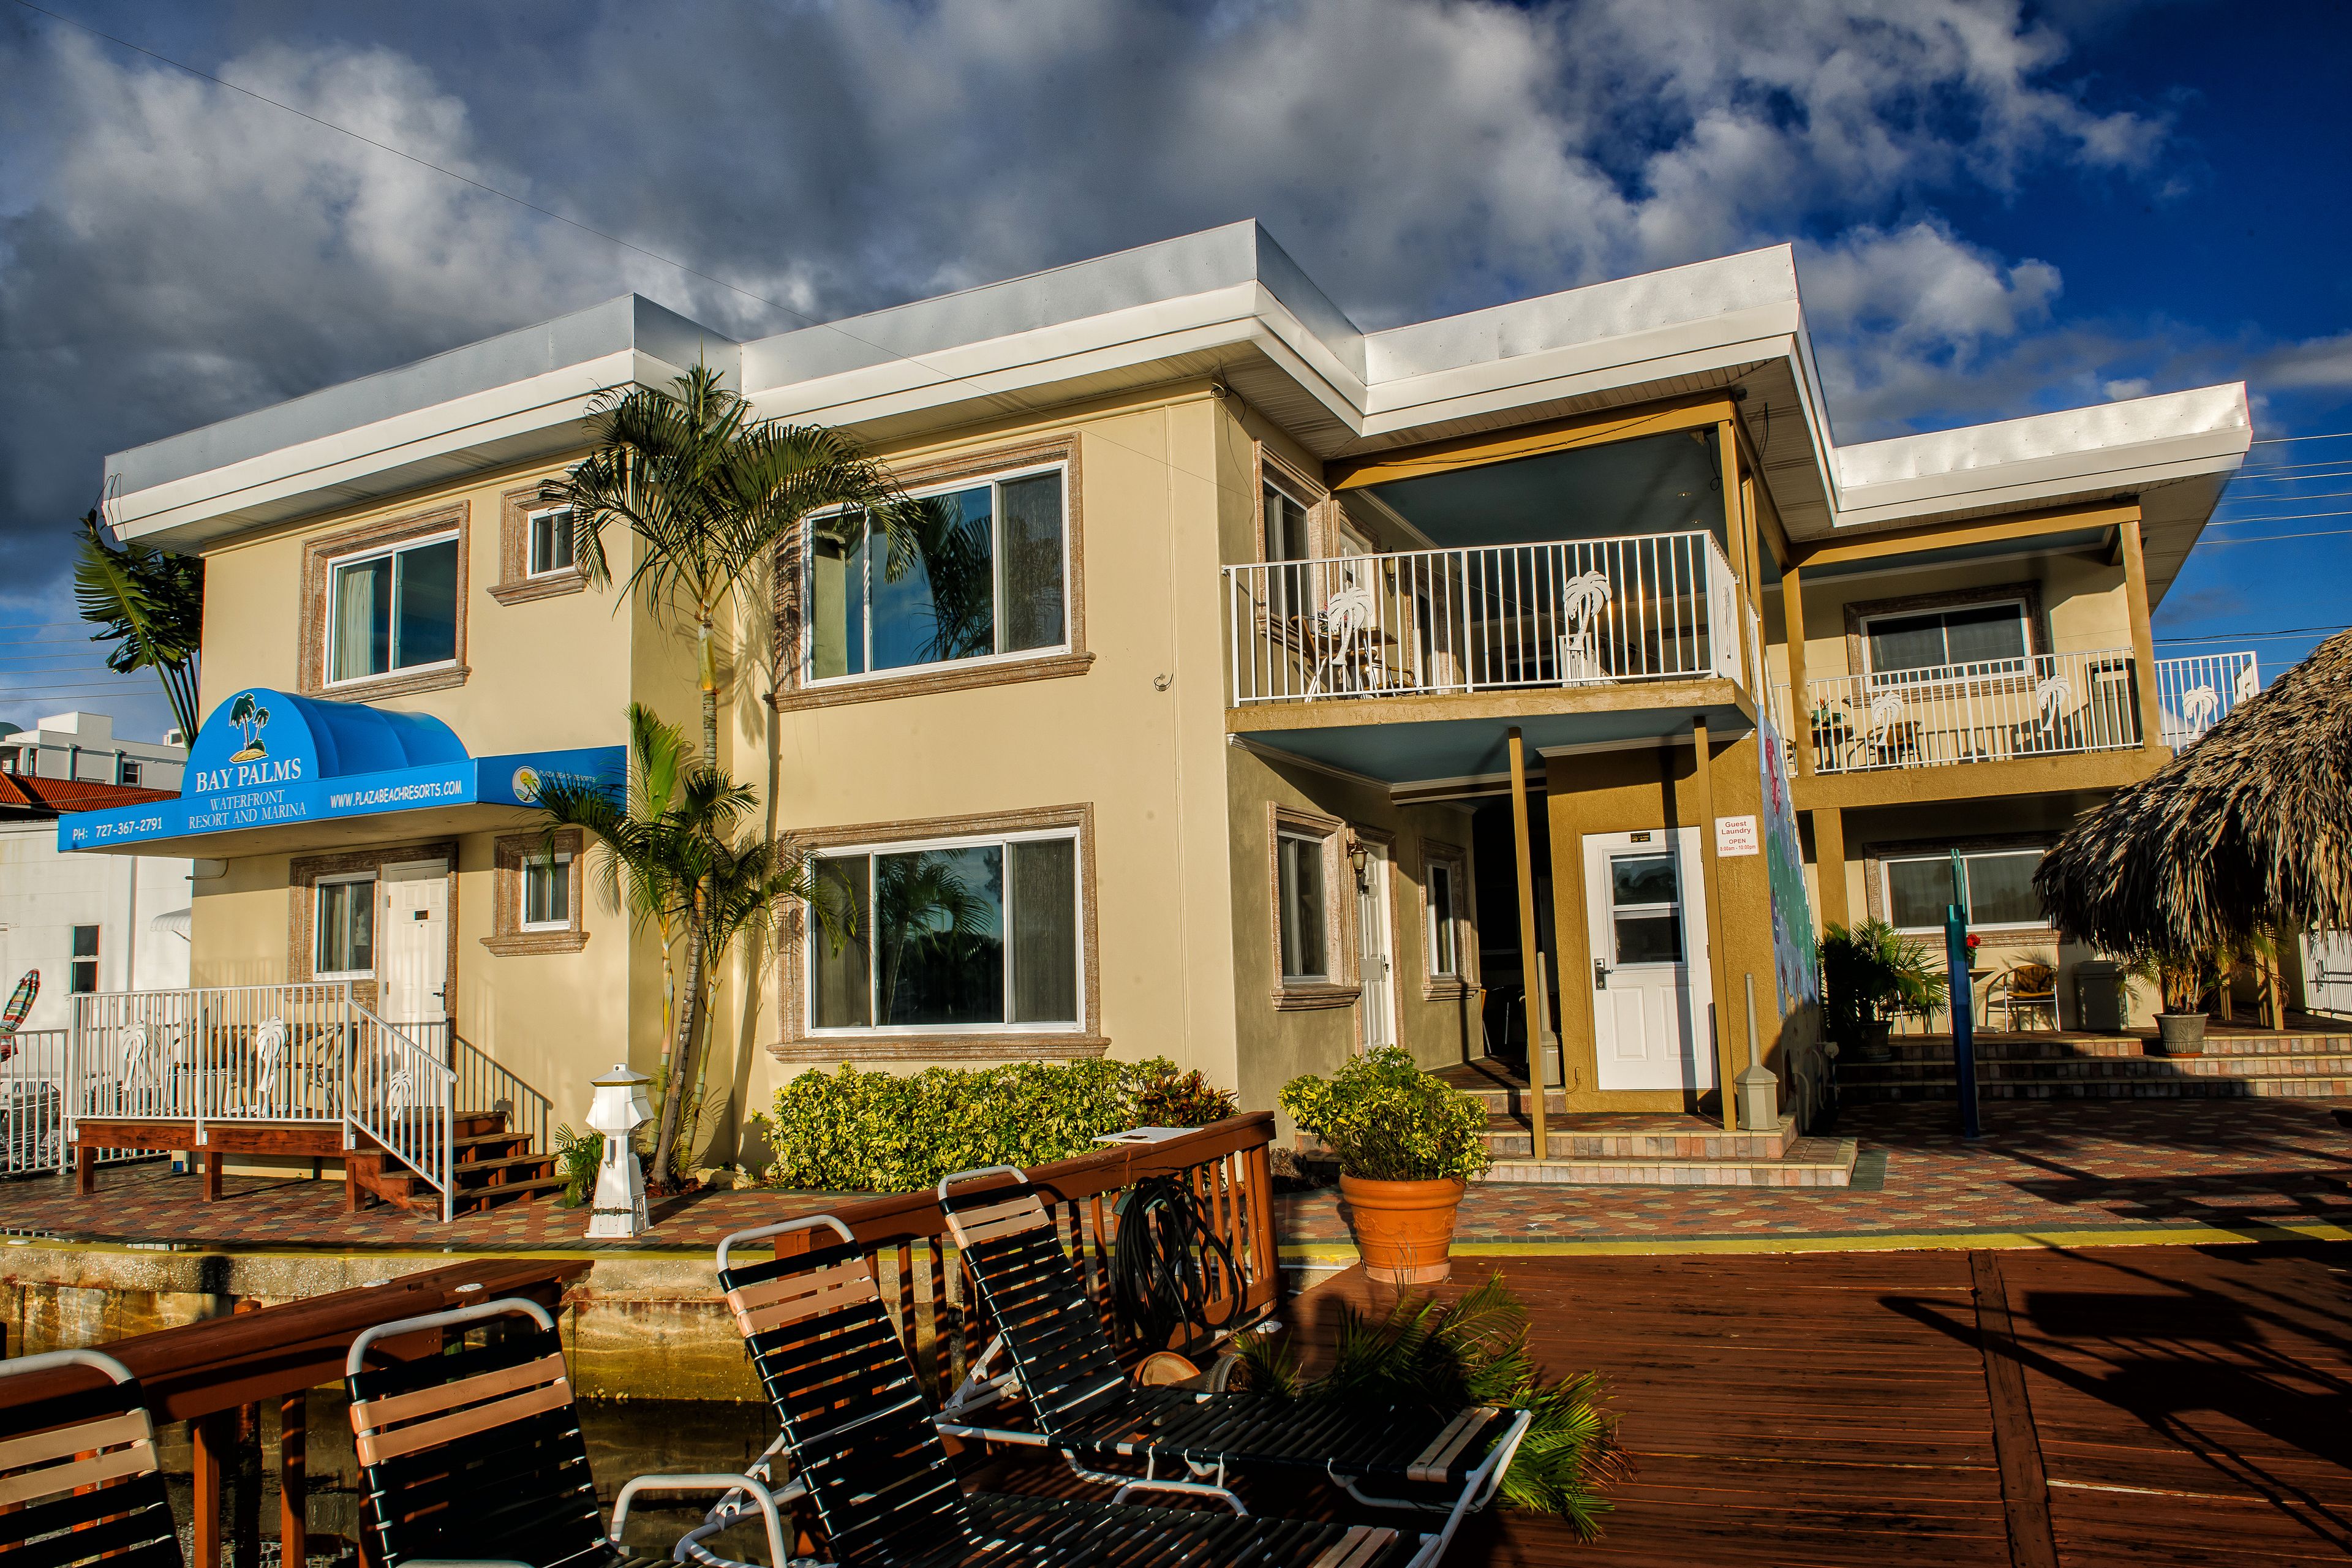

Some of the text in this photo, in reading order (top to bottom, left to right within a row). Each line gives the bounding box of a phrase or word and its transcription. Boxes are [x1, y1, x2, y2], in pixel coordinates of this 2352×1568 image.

[195, 758, 302, 793] BAY PALMS
[210, 789, 285, 812] WATERFRONT
[330, 780, 462, 808] WWW.PLAZABEACHRESORTS.COM
[72, 816, 162, 840] PH: 727-367-2791
[189, 802, 306, 829] RESORT AND MARINA
